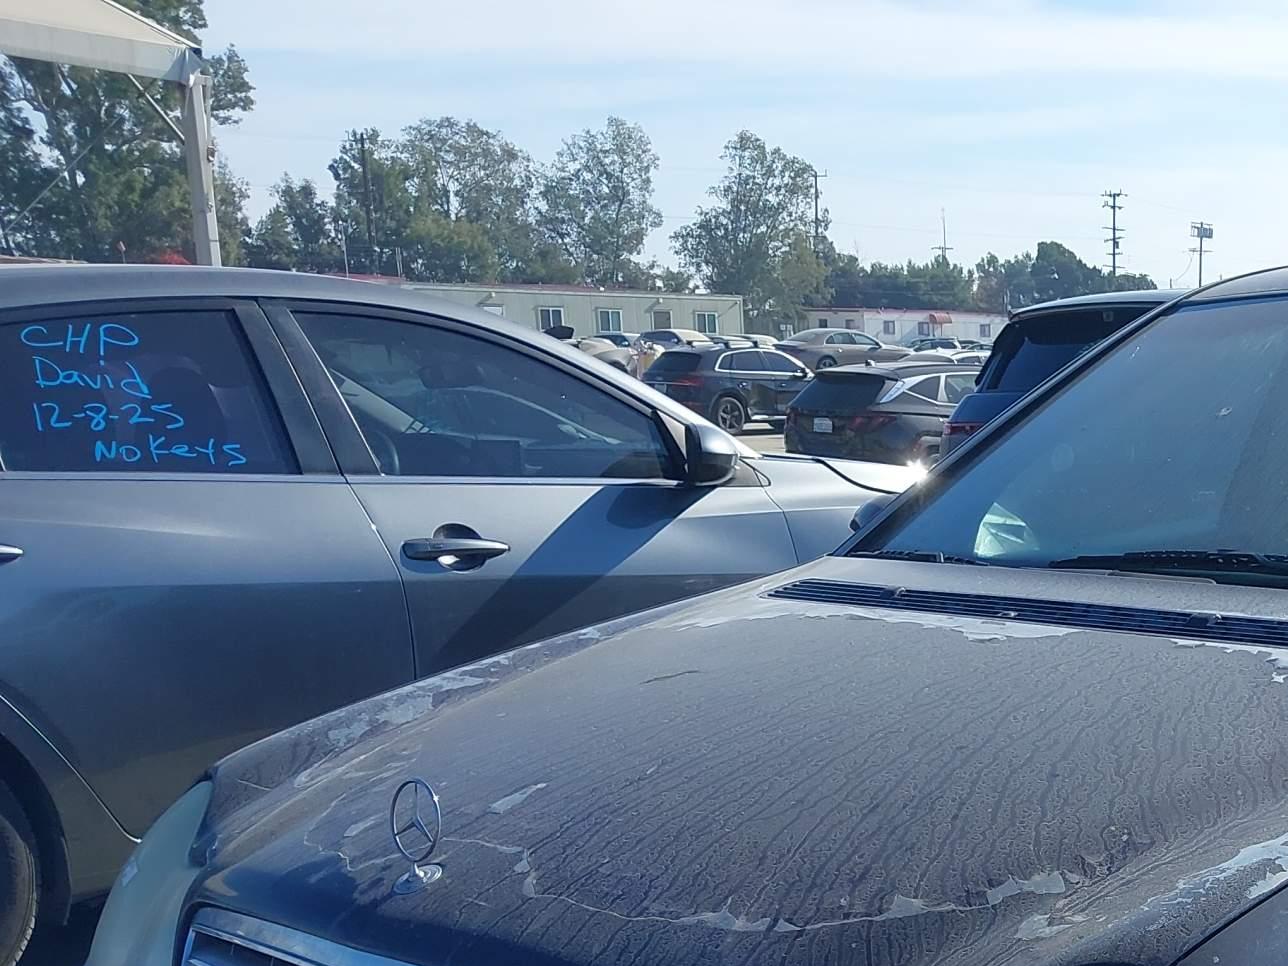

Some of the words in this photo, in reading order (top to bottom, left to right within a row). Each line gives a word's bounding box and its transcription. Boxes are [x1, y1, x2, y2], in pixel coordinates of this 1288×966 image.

[21, 323, 139, 355] CHP
[32, 356, 152, 399] David
[33, 403, 184, 431] 12-8-25
